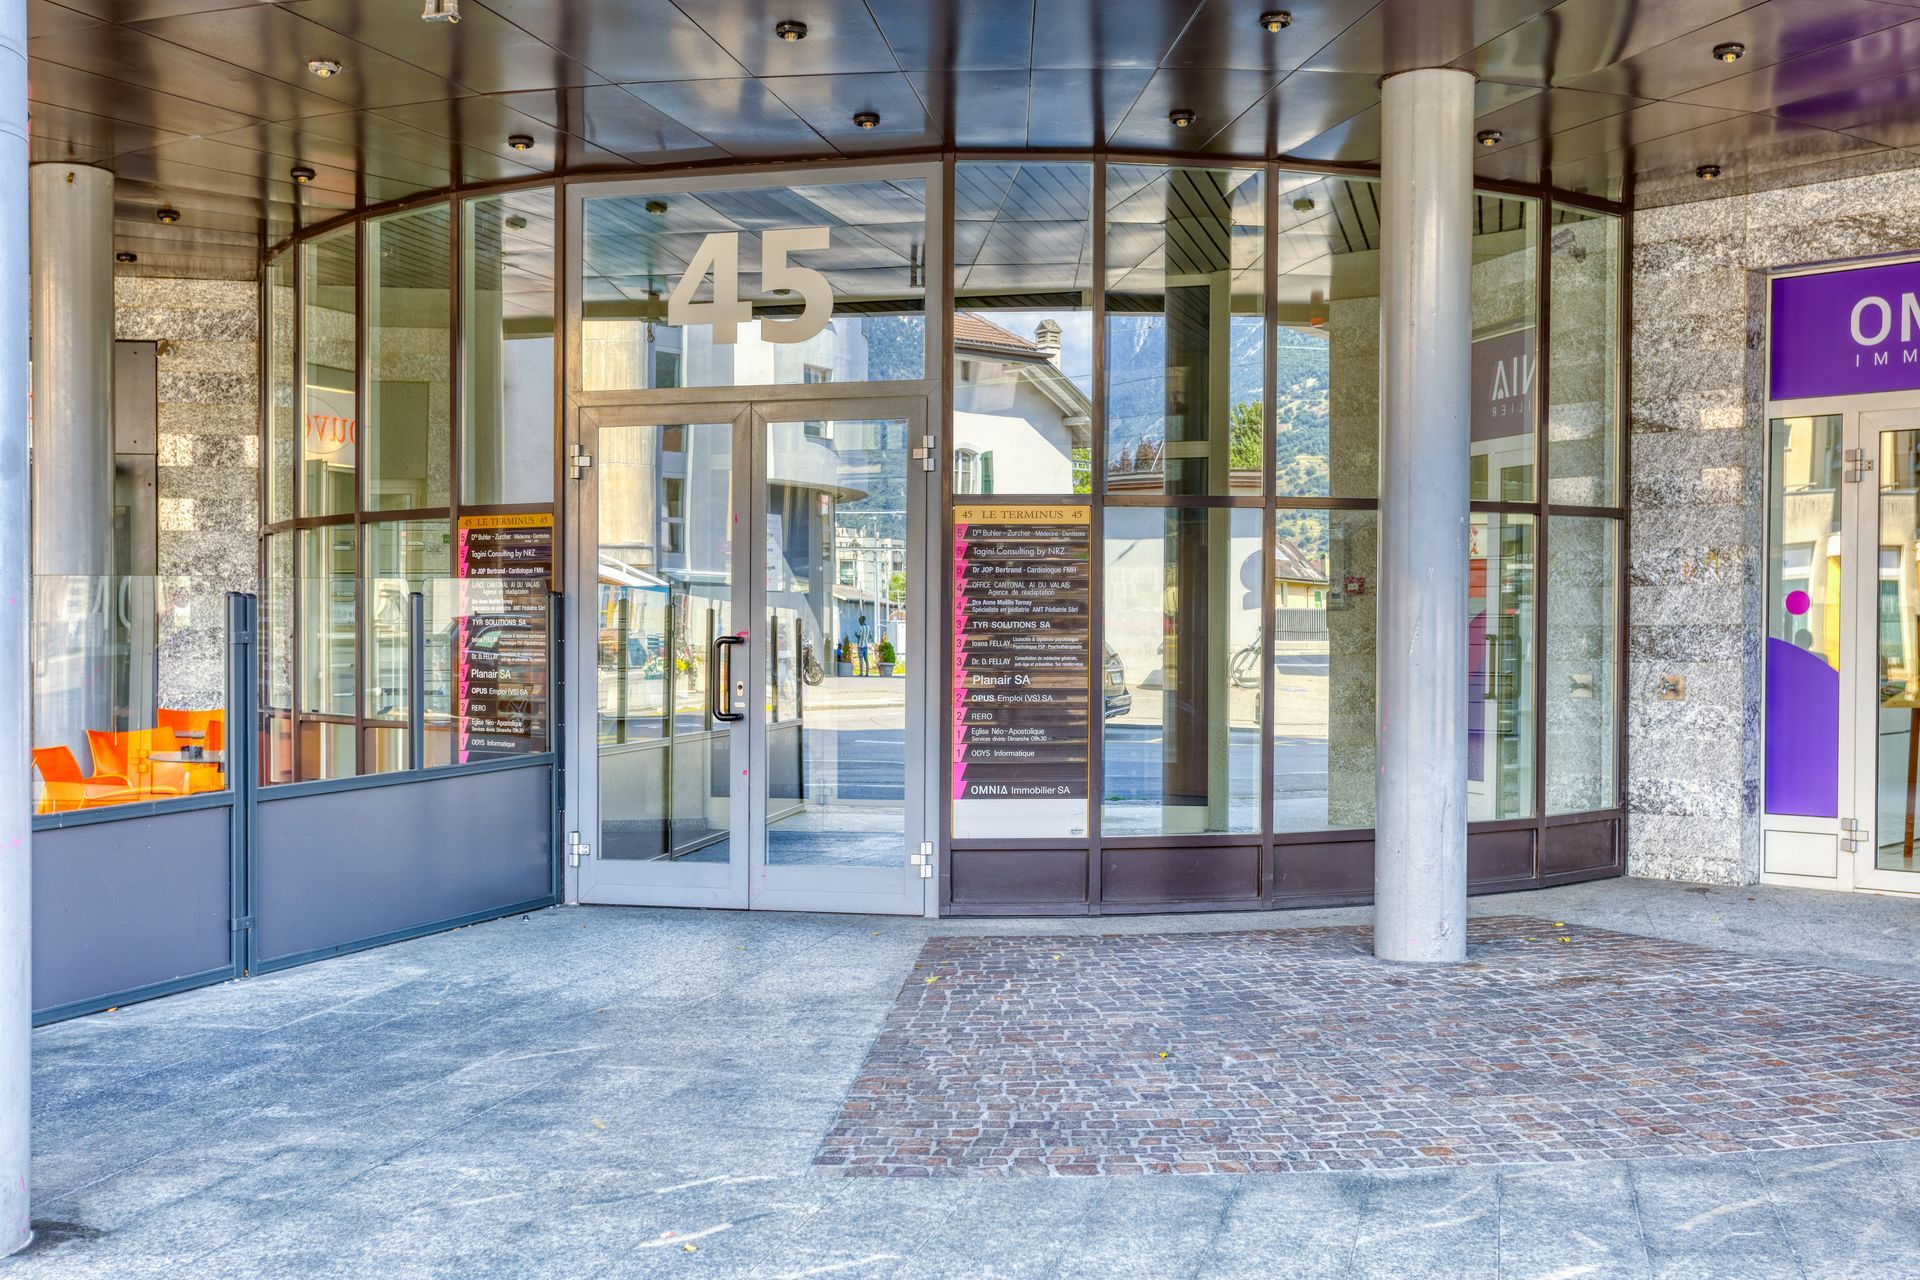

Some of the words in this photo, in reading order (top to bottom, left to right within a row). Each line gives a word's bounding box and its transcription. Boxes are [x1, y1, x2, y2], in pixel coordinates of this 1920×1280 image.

[668, 227, 833, 344] 45
[1856, 348, 1918, 367] IMM
[962, 511, 973, 519] 45
[982, 511, 997, 519] LE
[1001, 511, 1064, 519] TERMINUS
[1072, 511, 1082, 519] 45
[957, 528, 963, 537] 5
[487, 549, 514, 558] Consulting
[515, 548, 522, 558] by
[957, 546, 962, 555] 5
[996, 547, 1034, 556] Consulting
[1036, 547, 1046, 556] by
[957, 565, 962, 575] 5
[957, 583, 963, 591] 4
[956, 620, 962, 629] 3
[956, 639, 962, 647] 3
[956, 657, 962, 666] 3
[471, 669, 498, 679] Planair
[500, 670, 511, 679] SA
[972, 675, 1012, 685] Planair
[1014, 675, 1031, 685] SA
[956, 694, 962, 702] 2
[998, 695, 1023, 703] Emploi
[487, 740, 515, 748] Informatique
[971, 785, 1008, 794] OMNIA
[1011, 786, 1056, 794] Immobilier
[1057, 786, 1071, 794] SA
